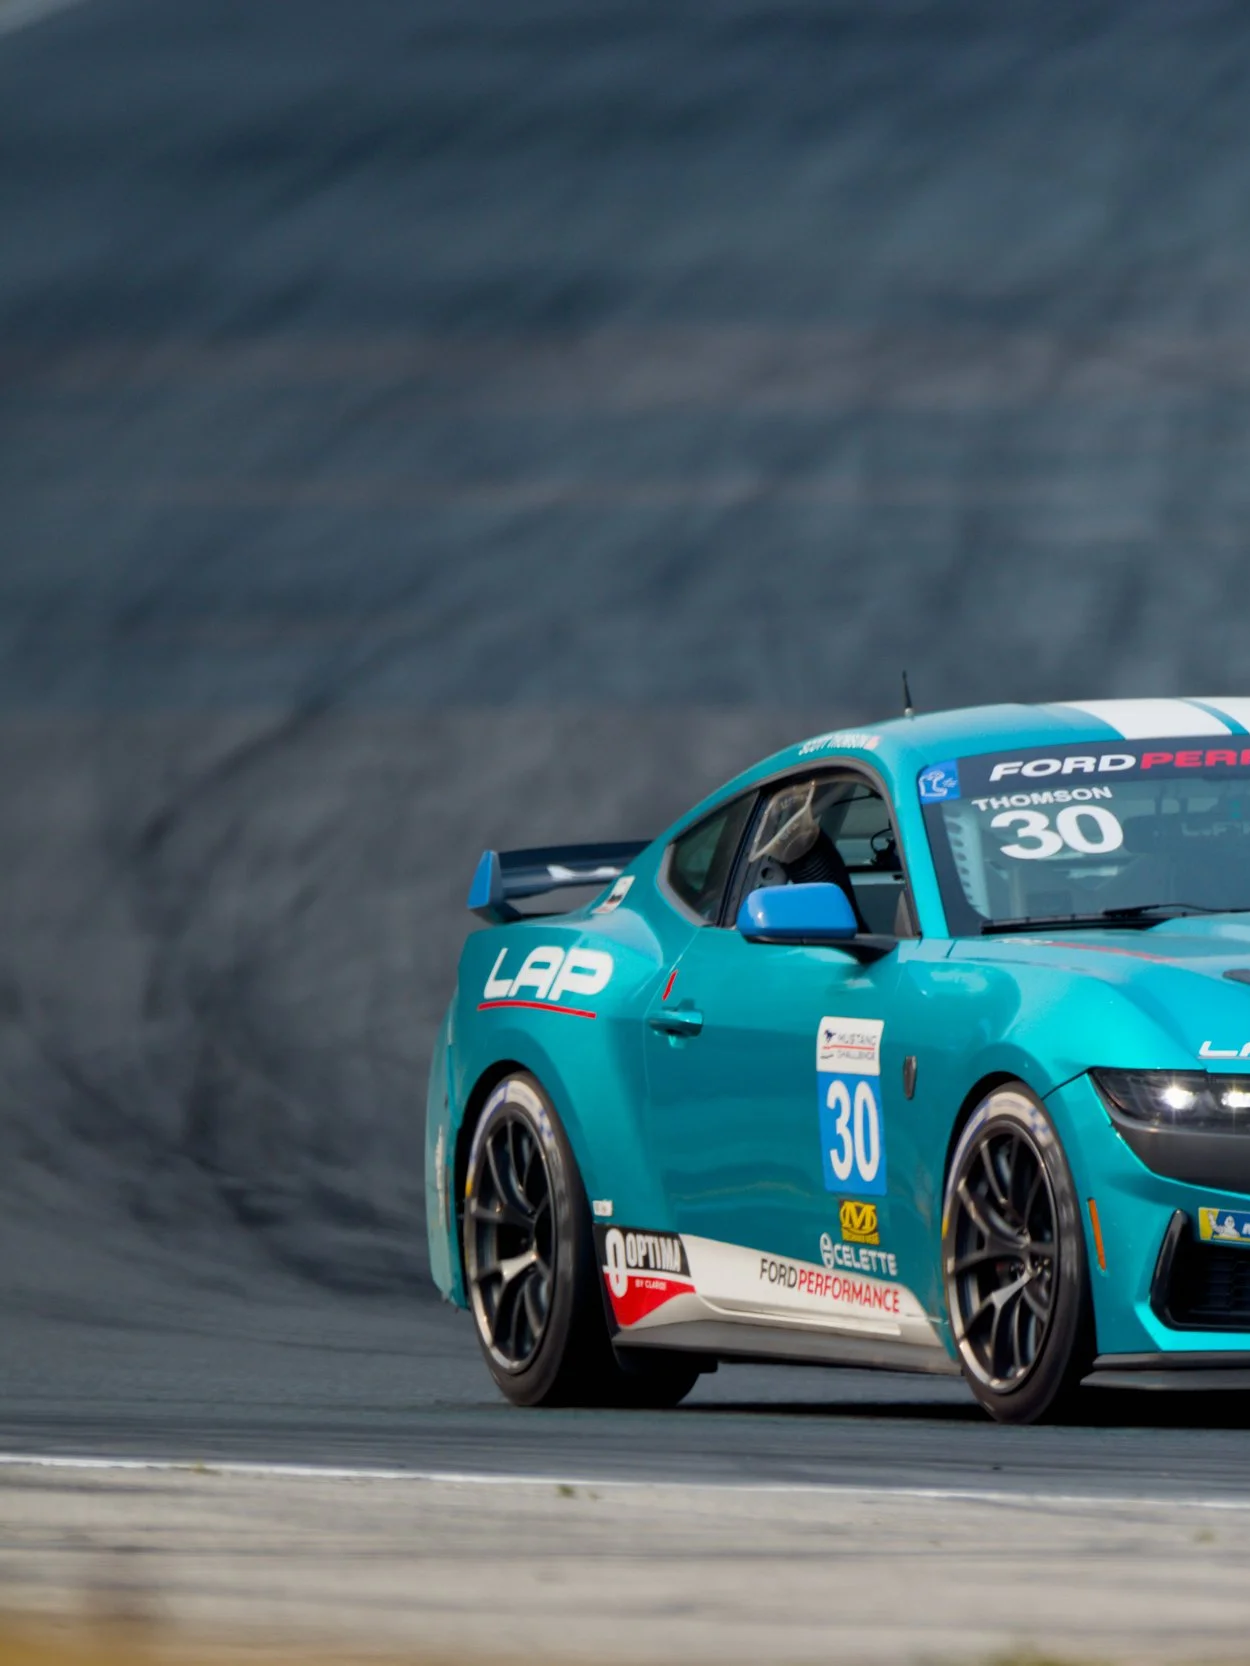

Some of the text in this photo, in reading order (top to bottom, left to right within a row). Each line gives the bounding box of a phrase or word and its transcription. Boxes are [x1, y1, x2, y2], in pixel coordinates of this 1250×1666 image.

[971, 785, 1113, 812] THOMSON
[990, 804, 1124, 860] 30
[483, 945, 614, 1001] LAP
[826, 1079, 881, 1183] 30
[625, 1232, 682, 1273] OPTIMA
[833, 1243, 898, 1276] CELETTE
